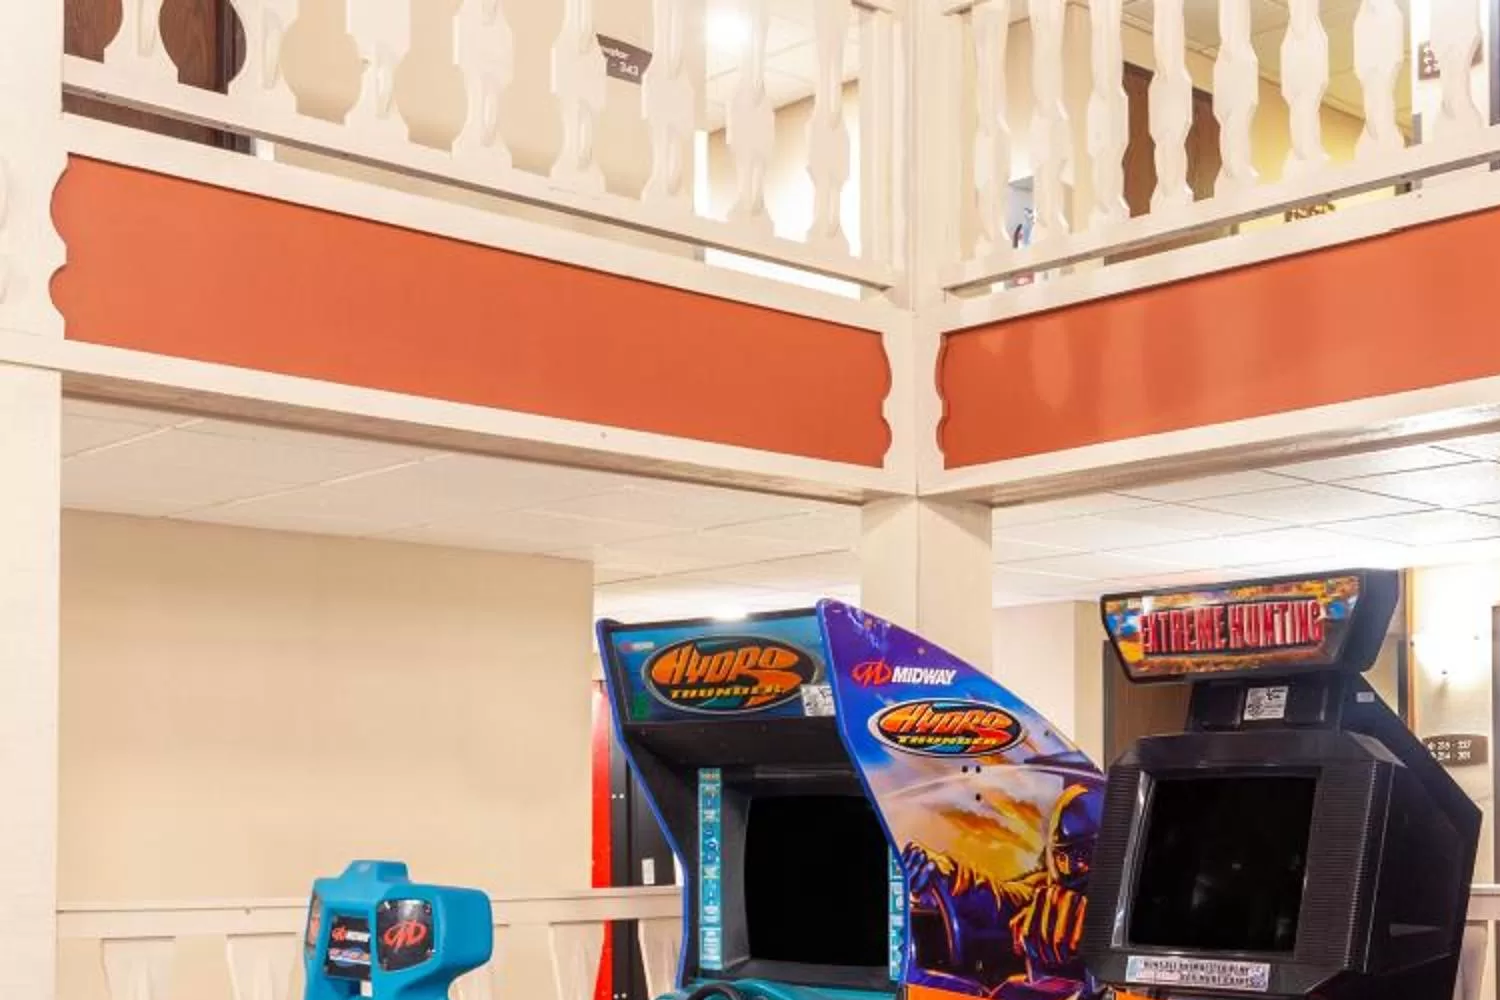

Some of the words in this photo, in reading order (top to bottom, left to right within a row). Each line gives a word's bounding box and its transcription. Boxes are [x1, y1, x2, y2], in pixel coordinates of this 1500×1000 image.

[1138, 604, 1227, 653] EXTREME
[1228, 599, 1326, 648] HUNTING
[891, 665, 957, 686] MIDWAY
